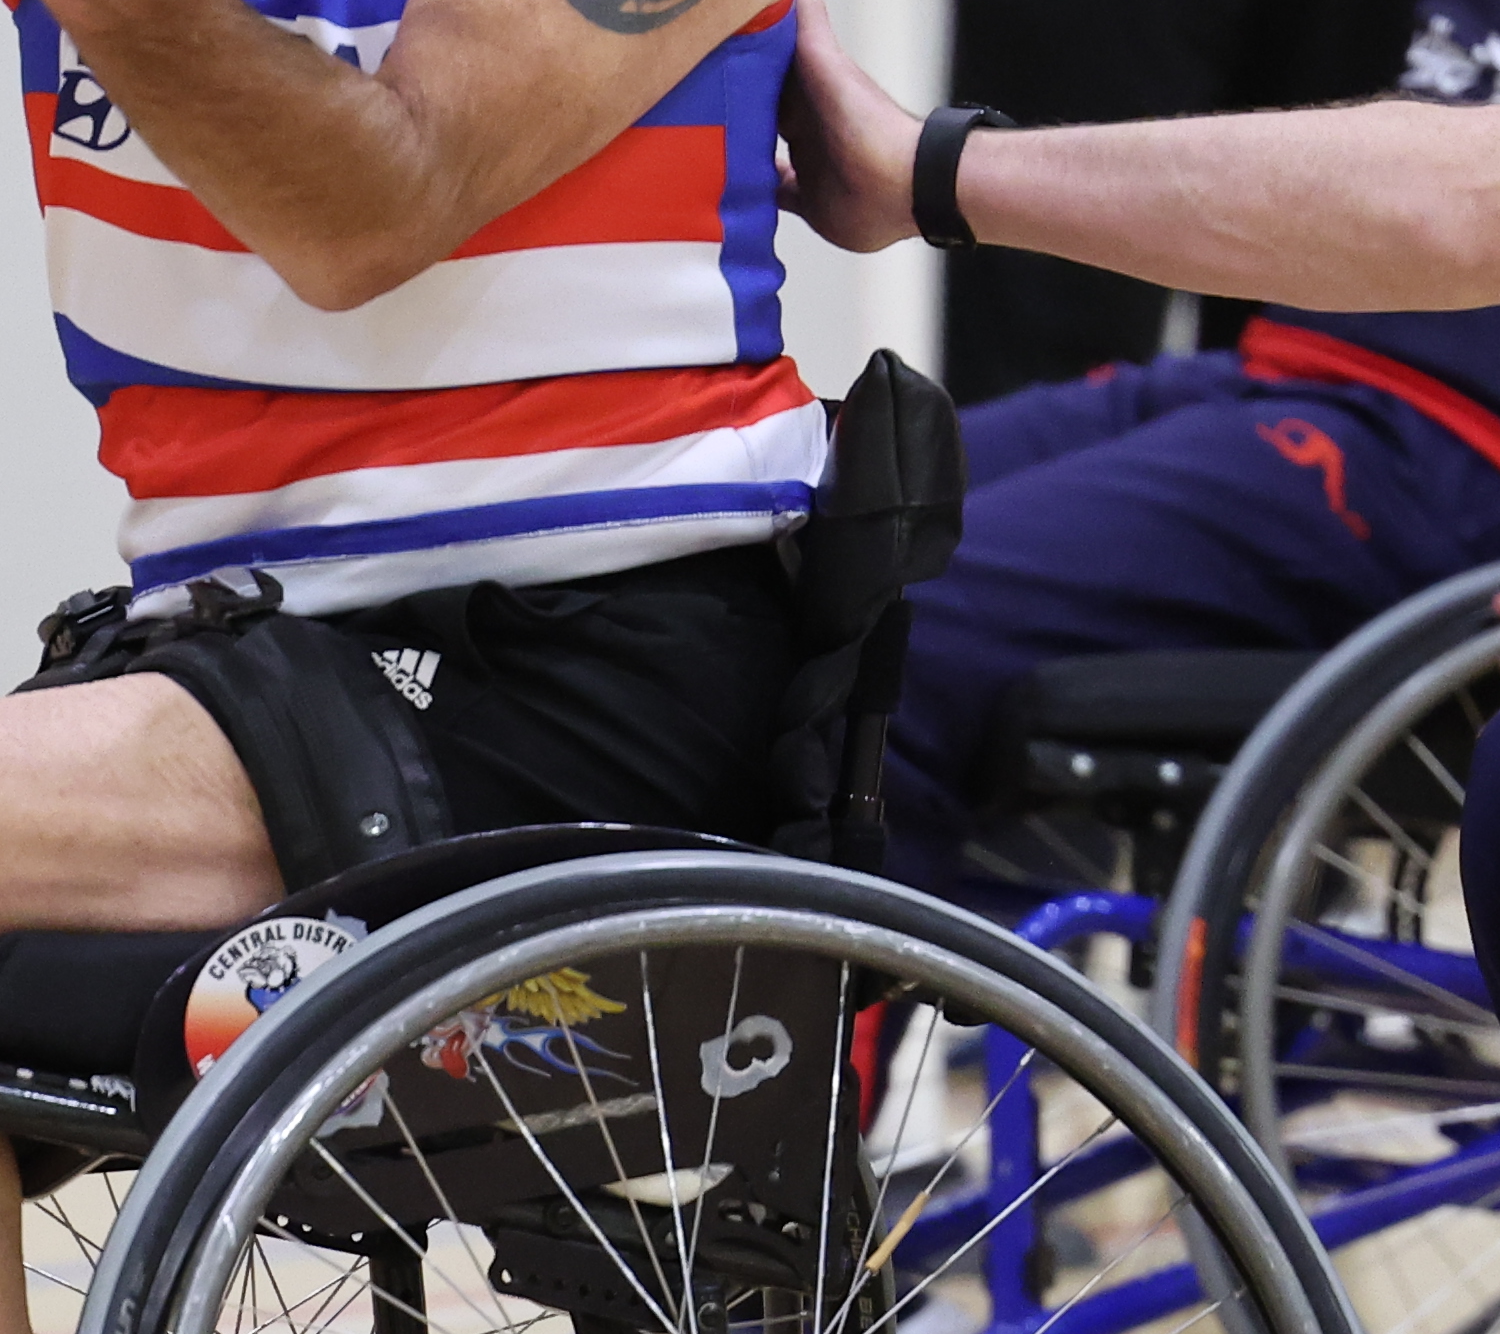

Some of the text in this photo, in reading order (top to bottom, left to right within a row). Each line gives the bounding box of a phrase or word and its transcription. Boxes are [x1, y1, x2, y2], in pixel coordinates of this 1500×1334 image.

[371, 650, 434, 711] adidas
[208, 921, 355, 981] CENTRAL DISTR
